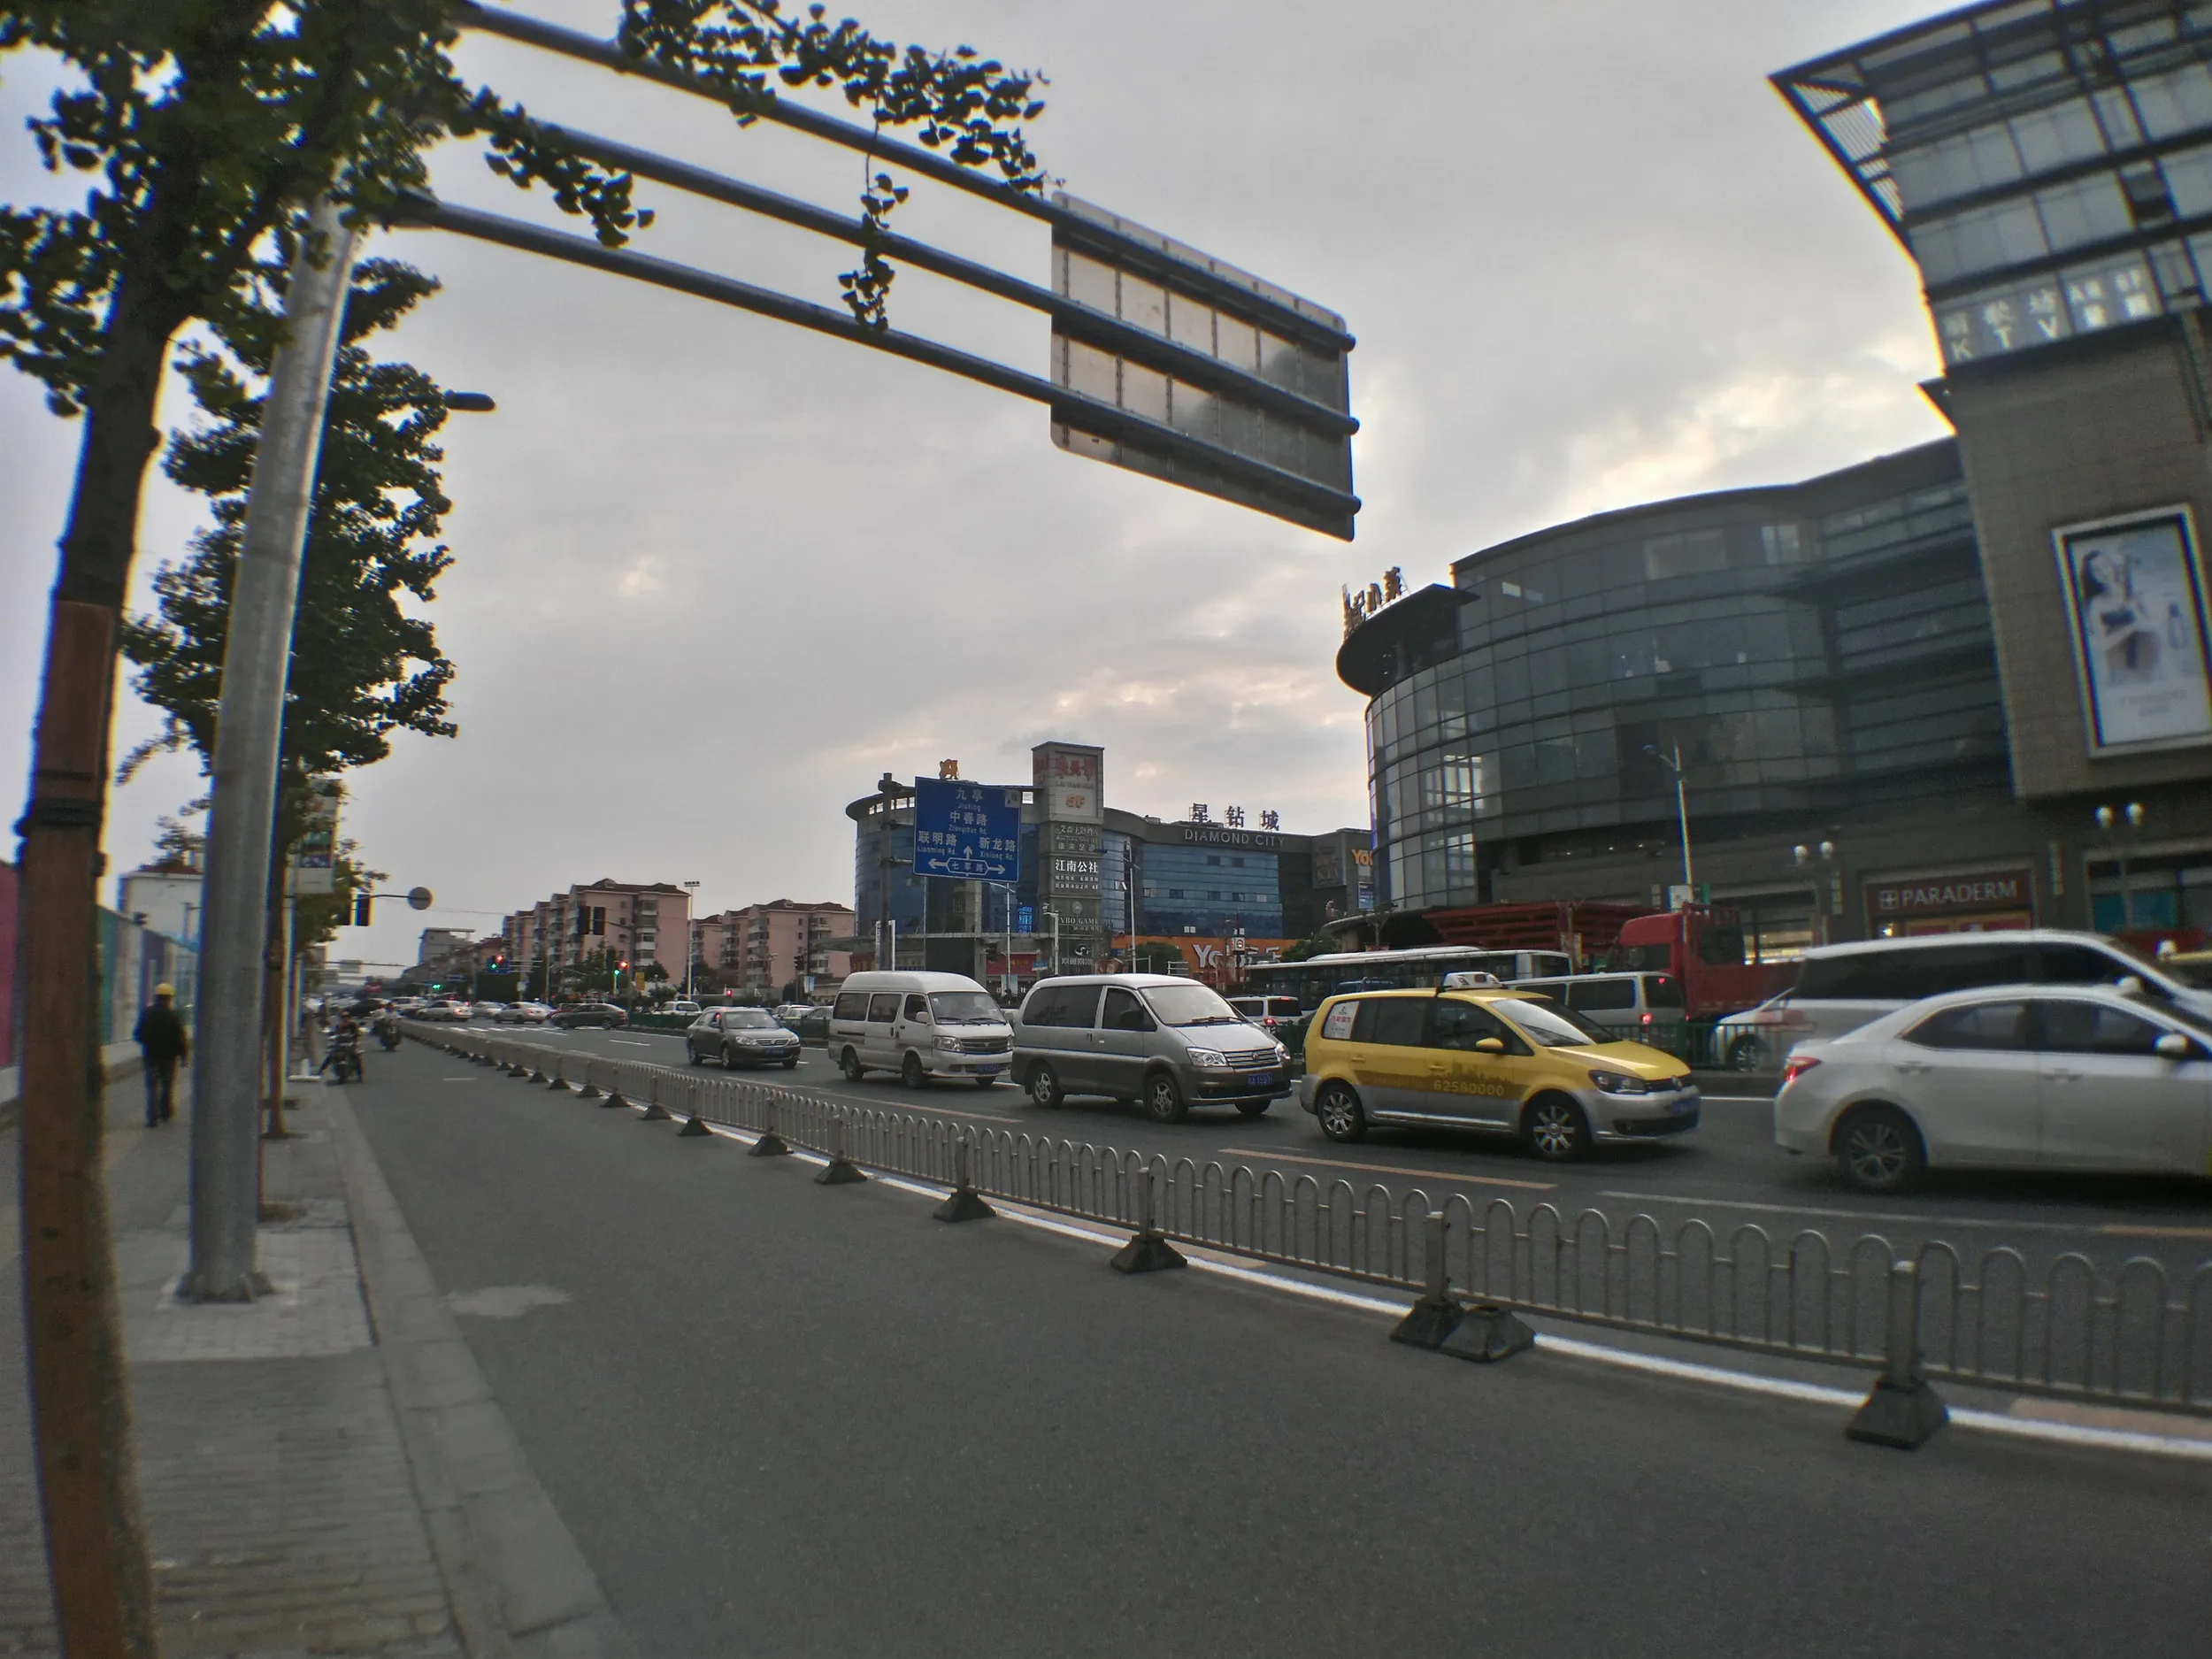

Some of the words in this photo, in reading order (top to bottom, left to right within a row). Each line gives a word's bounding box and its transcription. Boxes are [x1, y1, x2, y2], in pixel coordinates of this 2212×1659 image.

[956, 787, 983, 802] 九亭
[957, 803, 981, 812] Jiuting
[950, 810, 987, 826] 中春路
[1191, 803, 1279, 831] 星钻城
[918, 830, 957, 847] 联明路
[979, 837, 1016, 852] 新龙路
[1185, 829, 1249, 845] DIAMOND
[1256, 834, 1285, 848] CITY
[918, 845, 946, 856] Lianming
[980, 851, 1002, 861] Xinlong
[1056, 858, 1099, 873] 江南公社
[1902, 879, 2017, 906] PARADERM
[1433, 1079, 1504, 1097] 62580000
